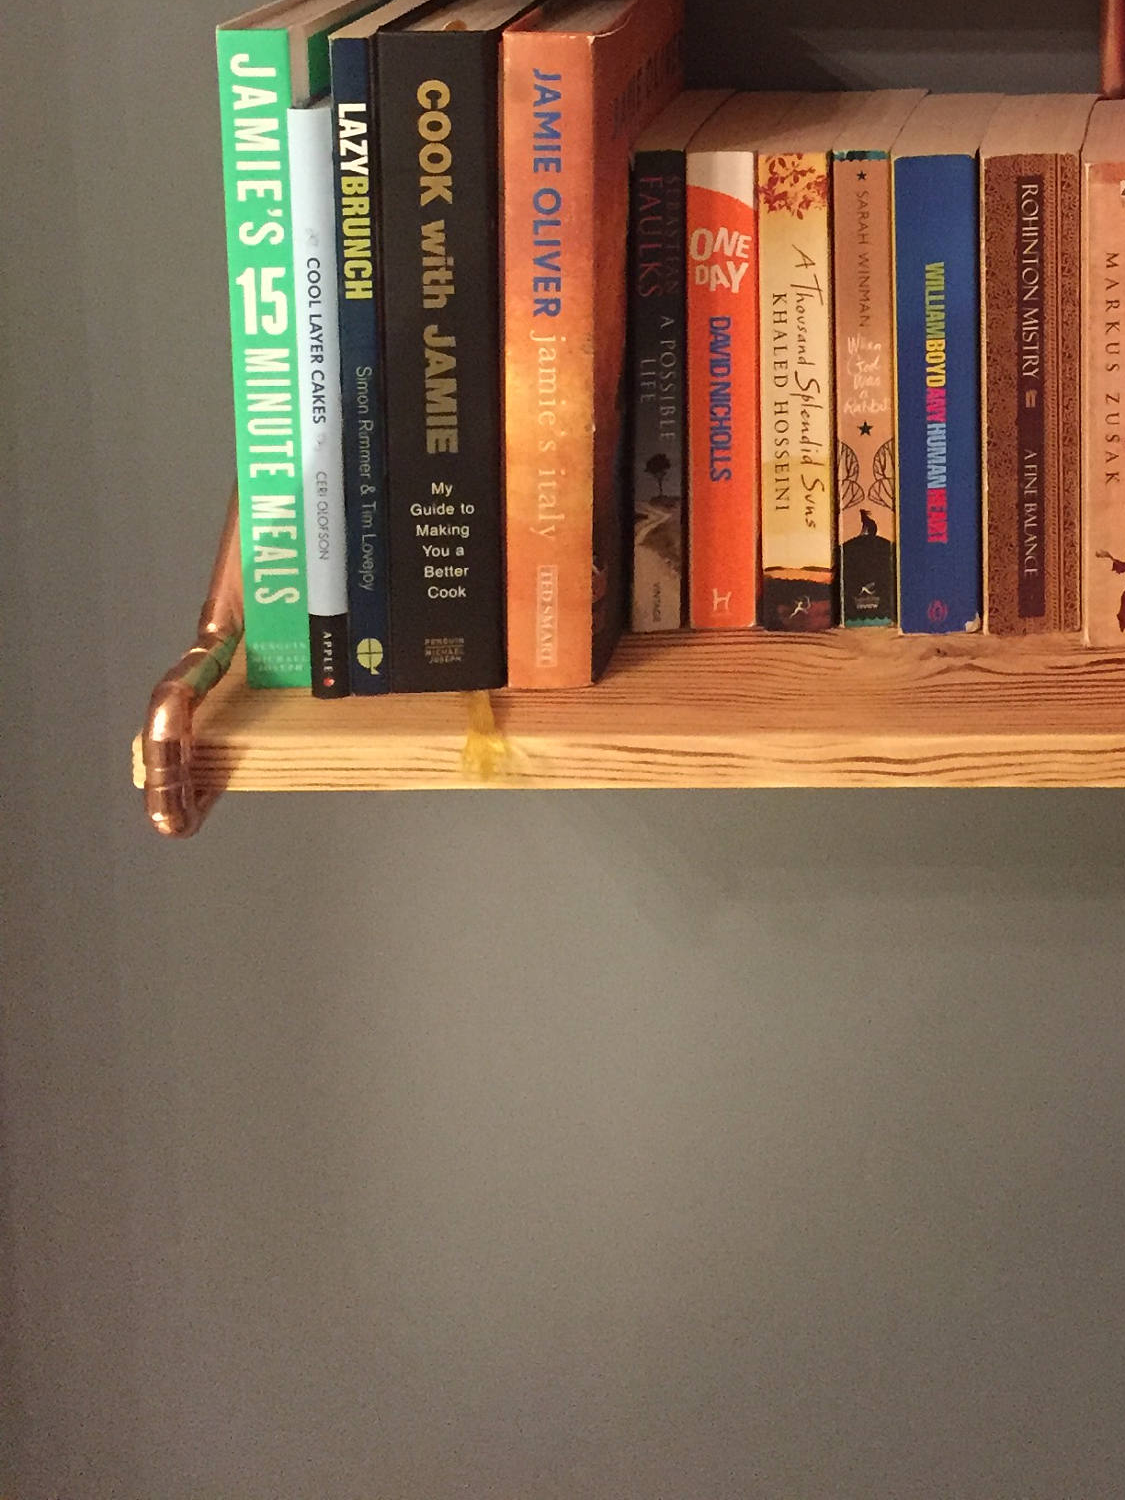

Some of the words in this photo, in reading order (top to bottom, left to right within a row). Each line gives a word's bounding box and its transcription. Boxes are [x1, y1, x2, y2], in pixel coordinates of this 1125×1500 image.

[230, 53, 285, 245] JAMIE'S
[416, 79, 453, 206] COOK
[532, 68, 562, 174] JAMIE
[532, 187, 562, 318] OLIVER
[689, 227, 753, 261] ONE
[856, 190, 870, 245] SARAH
[307, 257, 321, 308] COOL
[421, 220, 455, 309] with
[694, 261, 749, 294] DAY
[858, 253, 870, 328] WINMAN
[235, 266, 288, 335] 15
[1105, 252, 1120, 372] MARKUS
[309, 310, 324, 365] LAYER
[709, 316, 732, 382] DAVID
[772, 293, 789, 388] KHALED
[244, 348, 295, 478] MINUTE
[311, 370, 326, 425] CAKES
[423, 325, 459, 454] JAMIE
[530, 329, 567, 452] jamie's
[709, 384, 732, 483] NICHOLLS
[774, 401, 790, 511] HOSSEINI
[1105, 392, 1120, 484] ZUSAK
[410, 503, 455, 516] Guide
[461, 503, 475, 515] to
[431, 482, 453, 497] My
[530, 469, 566, 540] italy
[251, 495, 300, 604] MEALS
[316, 499, 329, 561] OLOFSON
[416, 524, 470, 538] Making
[422, 545, 450, 557] You
[424, 566, 469, 578] Better
[428, 586, 466, 598] Cook
